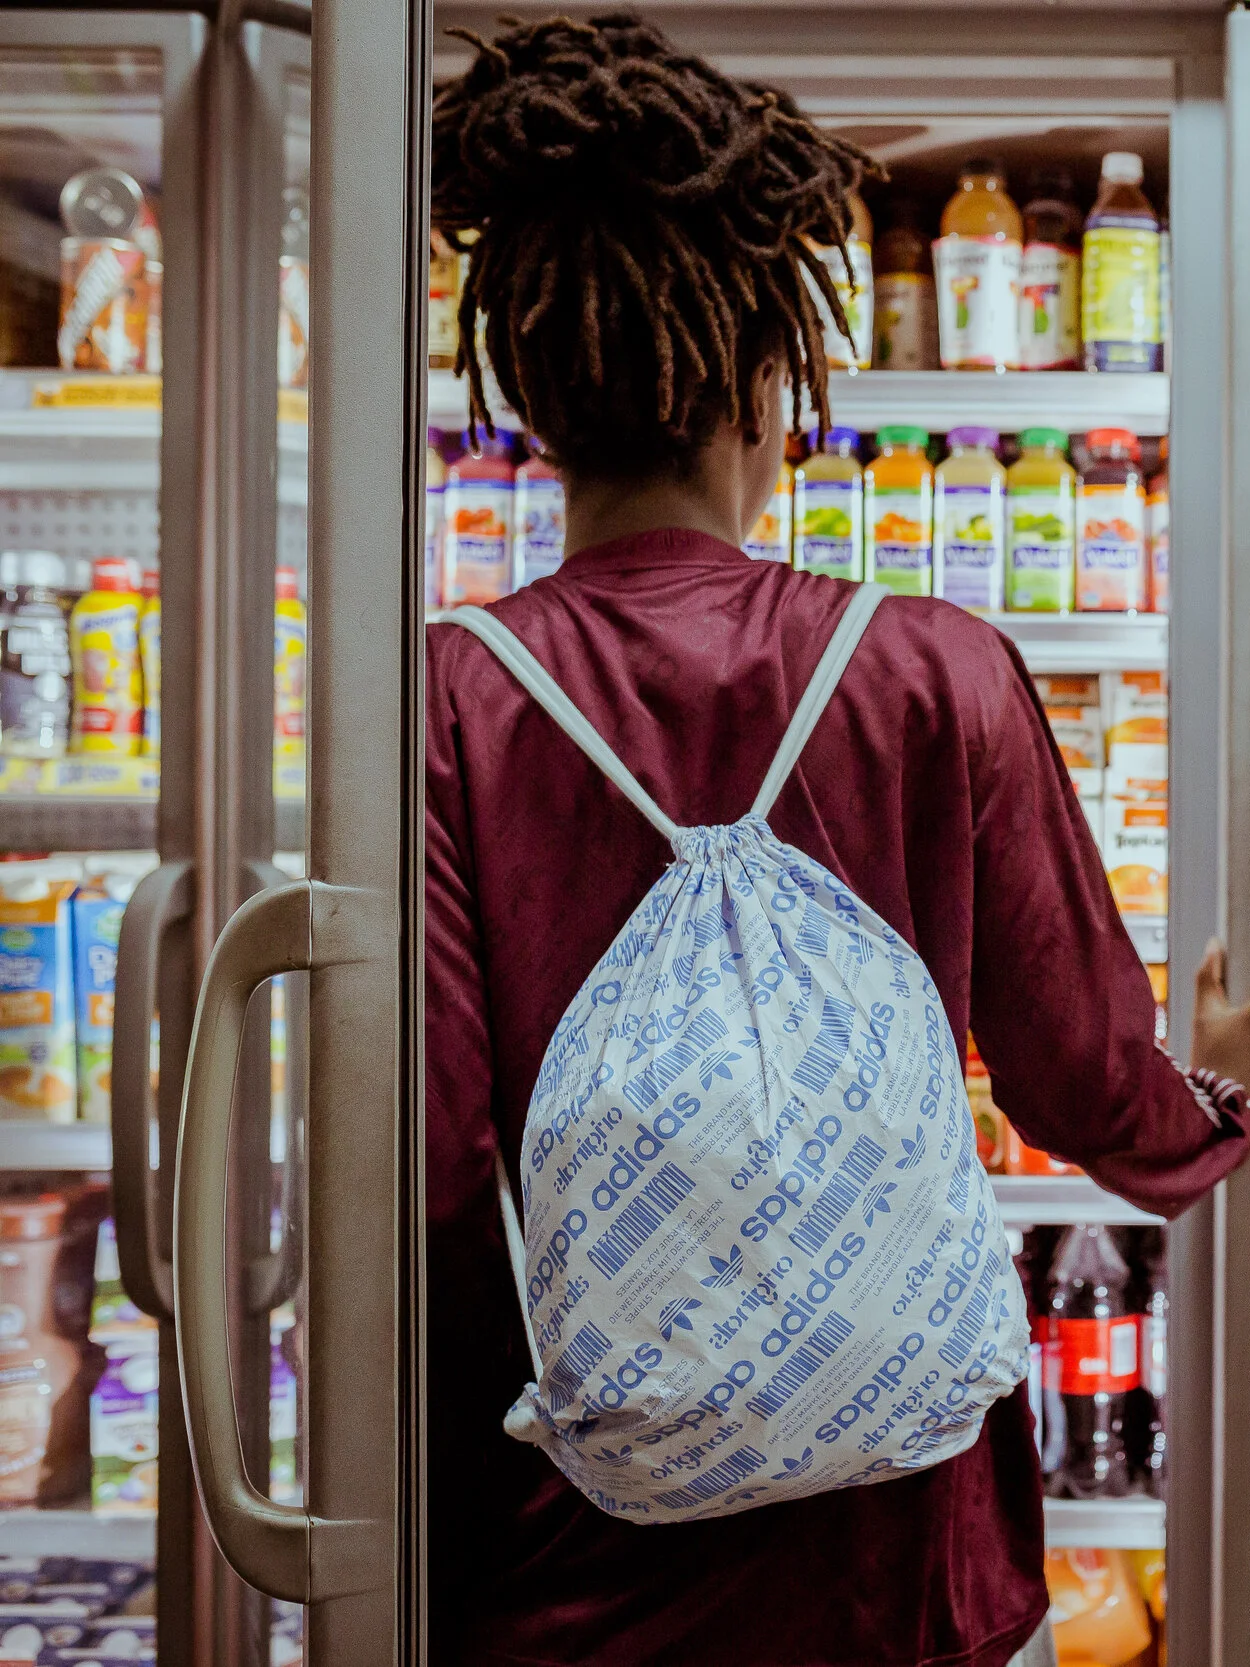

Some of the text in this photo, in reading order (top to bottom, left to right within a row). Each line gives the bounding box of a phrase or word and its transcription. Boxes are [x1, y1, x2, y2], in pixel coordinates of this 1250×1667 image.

[790, 1045, 842, 1095] WANG
[843, 1001, 895, 1112] adidas
[880, 1072, 898, 1101] BRAND
[896, 1039, 909, 1055] THE
[919, 1004, 945, 1120] adidas
[532, 1062, 614, 1173] adidas
[687, 1132, 704, 1149] THE
[701, 1106, 729, 1134] BRAND
[725, 1088, 745, 1109] WITH
[743, 1075, 758, 1091] THE
[715, 1142, 727, 1155] LA
[724, 1113, 755, 1145] MARQUE
[726, 1108, 744, 1126] DEN
[741, 1095, 756, 1110] MIT
[592, 1092, 701, 1211] adidas
[689, 1129, 724, 1166] STREIFEN
[740, 1115, 844, 1243] adidas
[929, 1172, 941, 1187] DIE
[587, 1161, 698, 1280] ALEXANDER WANG
[708, 1214, 725, 1231] THE
[786, 1132, 888, 1257] ALEXANDER WANG
[900, 1186, 934, 1234] WELTMARKE
[608, 1310, 622, 1324] DIE
[618, 1267, 660, 1312] WELTMARKE
[657, 1253, 672, 1269] MIT
[669, 1237, 686, 1255] DEN
[688, 1197, 723, 1234] STREIFEN
[615, 1208, 697, 1298] LA MARQUE AUX 3 BANDES
[668, 1254, 688, 1275] WITH
[686, 1229, 711, 1256] BRAND
[848, 1278, 863, 1296] THE
[859, 1249, 882, 1280] BRAND
[878, 1229, 896, 1251] WITH
[892, 1213, 906, 1230] THE
[906, 1175, 930, 1208] STRIPES
[872, 1285, 882, 1297] LA
[880, 1252, 904, 1285] MARQUE
[900, 1236, 914, 1253] AUX
[914, 1199, 937, 1230] BANDES
[881, 1249, 895, 1267] DEN
[892, 1234, 905, 1249] MIT
[928, 1200, 988, 1327] adidas
[624, 1293, 653, 1324] STRIPES
[655, 1273, 671, 1290] THE
[761, 1231, 867, 1358] adidas
[849, 1271, 879, 1312] STREIFEN
[582, 1342, 662, 1421] didas
[640, 1392, 655, 1407] THE
[657, 1358, 689, 1390] STRIPES
[690, 1358, 705, 1372] DIE
[744, 1308, 856, 1421] ALEXANDER WANG
[815, 1332, 925, 1444] adidas
[901, 1340, 998, 1450] adidas
[635, 1359, 756, 1445] adidas
[650, 1421, 744, 1480] originals
